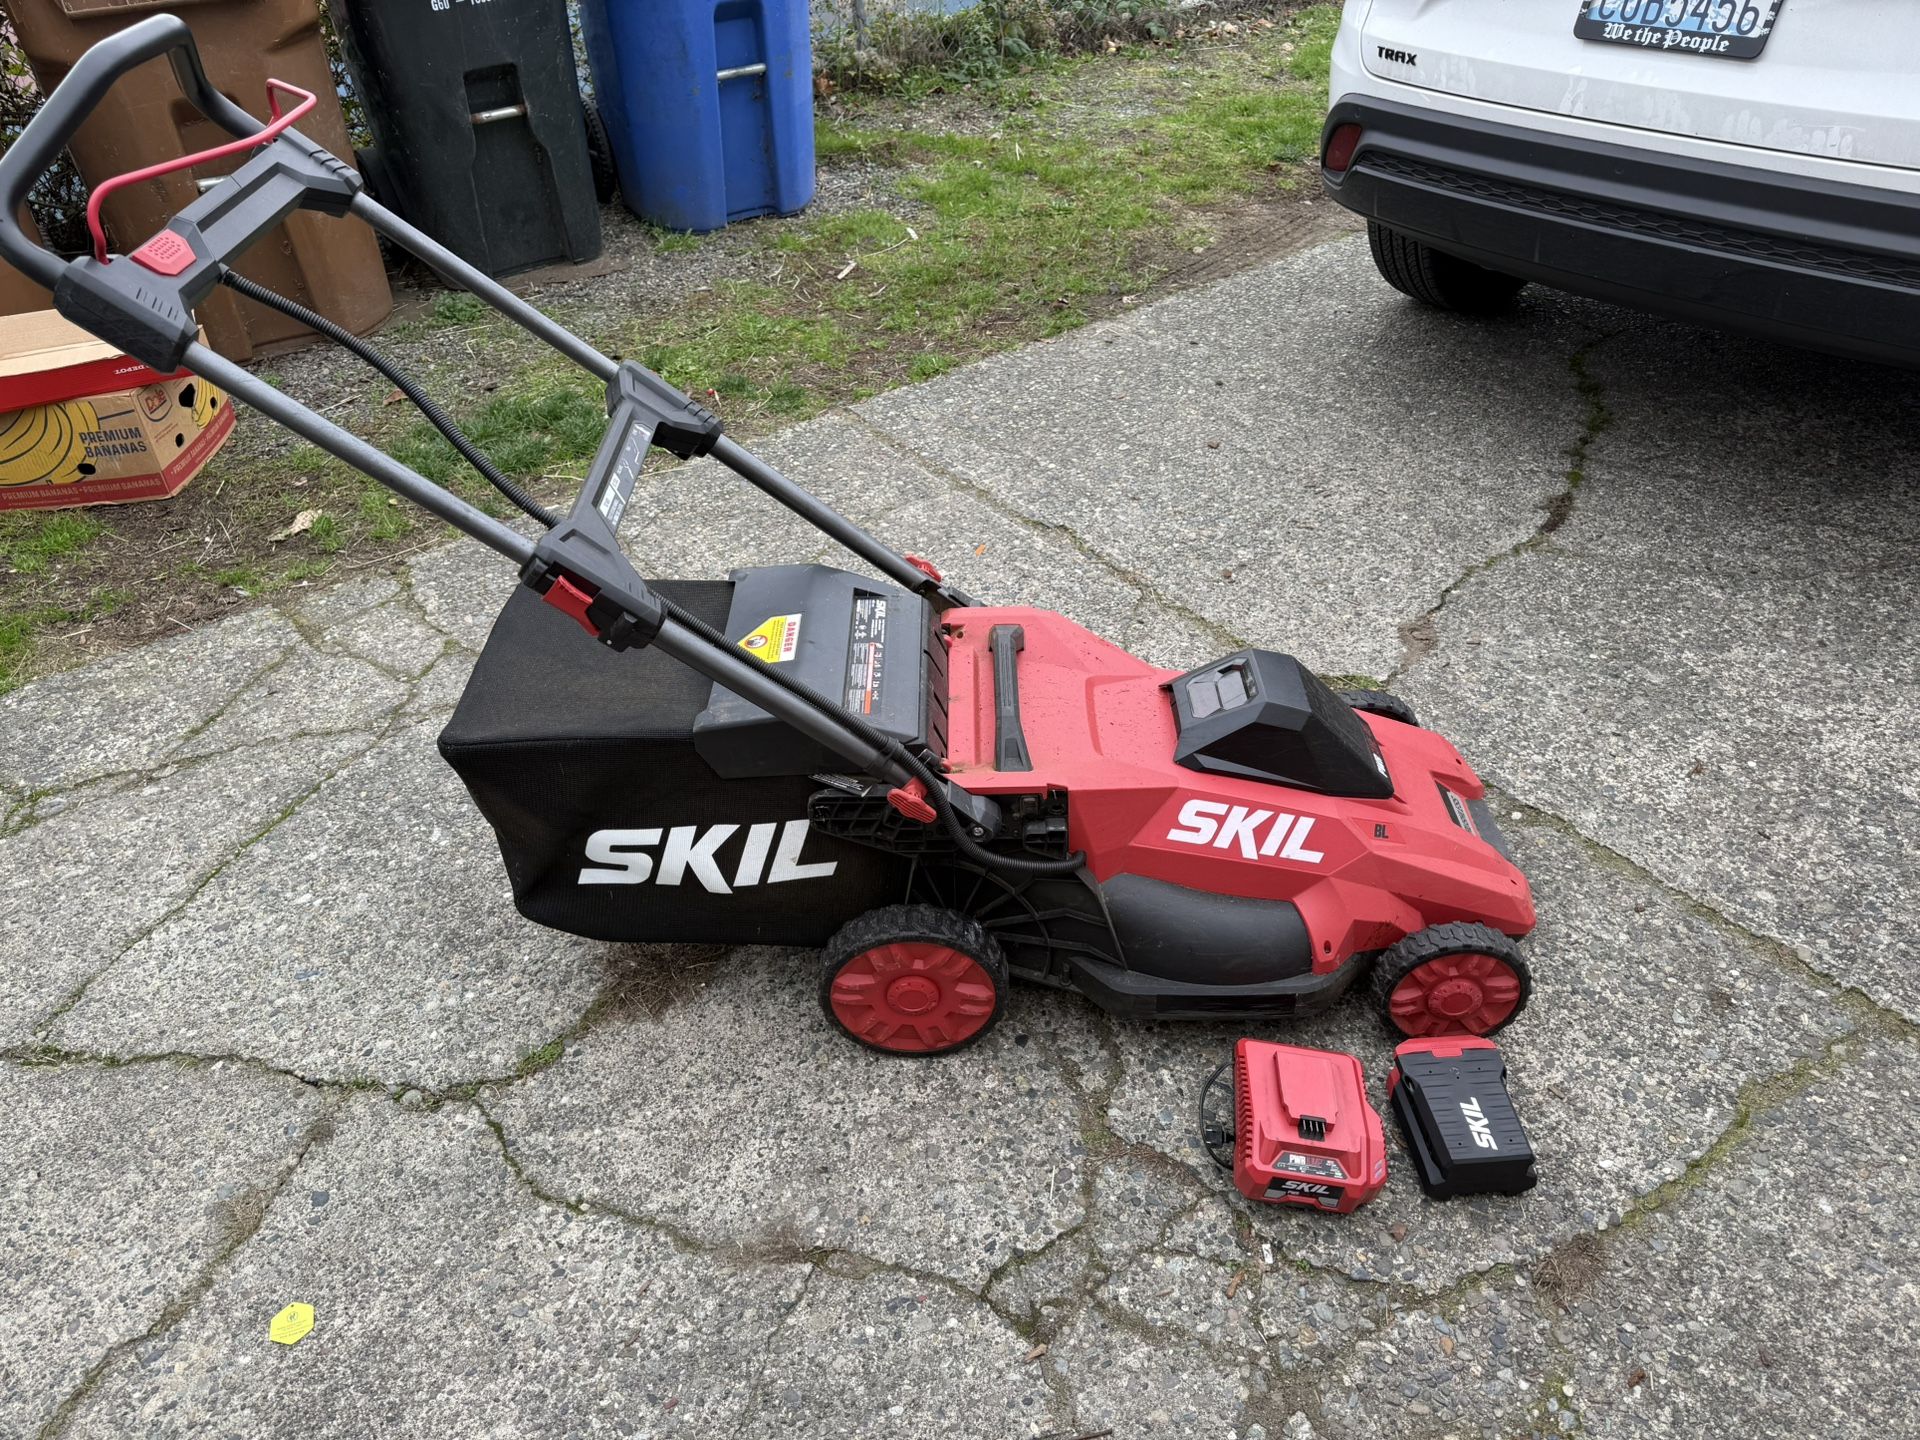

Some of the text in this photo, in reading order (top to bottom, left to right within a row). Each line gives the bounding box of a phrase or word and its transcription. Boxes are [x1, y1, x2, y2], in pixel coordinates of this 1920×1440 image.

[1603, 22, 1730, 52] We the People
[1377, 45, 1417, 66] TRAX
[114, 364, 145, 375] DEPOT
[78, 426, 142, 445] PREMIUM
[85, 441, 147, 458] BANANAS
[783, 621, 796, 652] DANGER
[1166, 799, 1325, 864] SKIL
[1374, 823, 1389, 839] BL
[577, 818, 838, 894] SKIL
[1459, 1096, 1499, 1151] SKIL
[1281, 1180, 1330, 1195] SKIL
